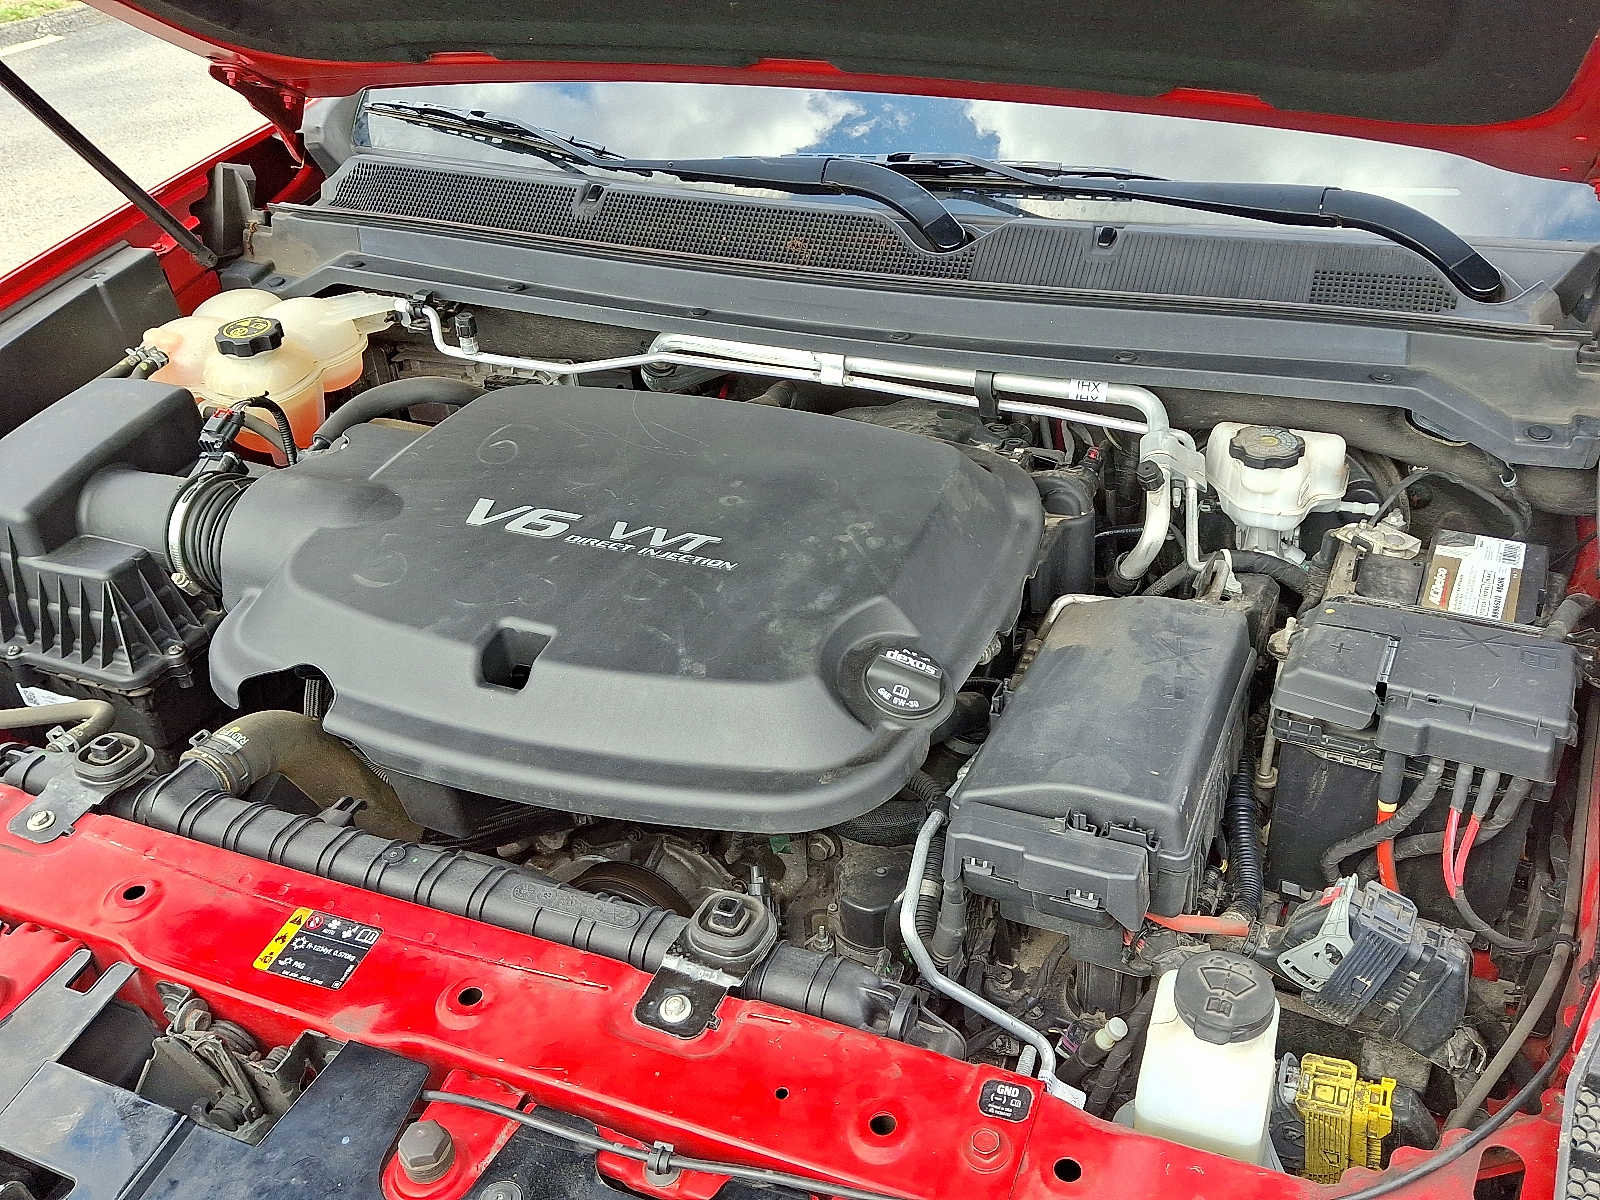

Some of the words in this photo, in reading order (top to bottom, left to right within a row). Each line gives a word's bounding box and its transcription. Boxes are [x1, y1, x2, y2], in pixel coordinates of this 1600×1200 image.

[466, 498, 583, 538] V6
[609, 521, 723, 552] VVT
[564, 535, 635, 552] DIRECT
[637, 547, 740, 571] INJECTION
[885, 649, 938, 675] dexos
[996, 1084, 1020, 1098] GND
